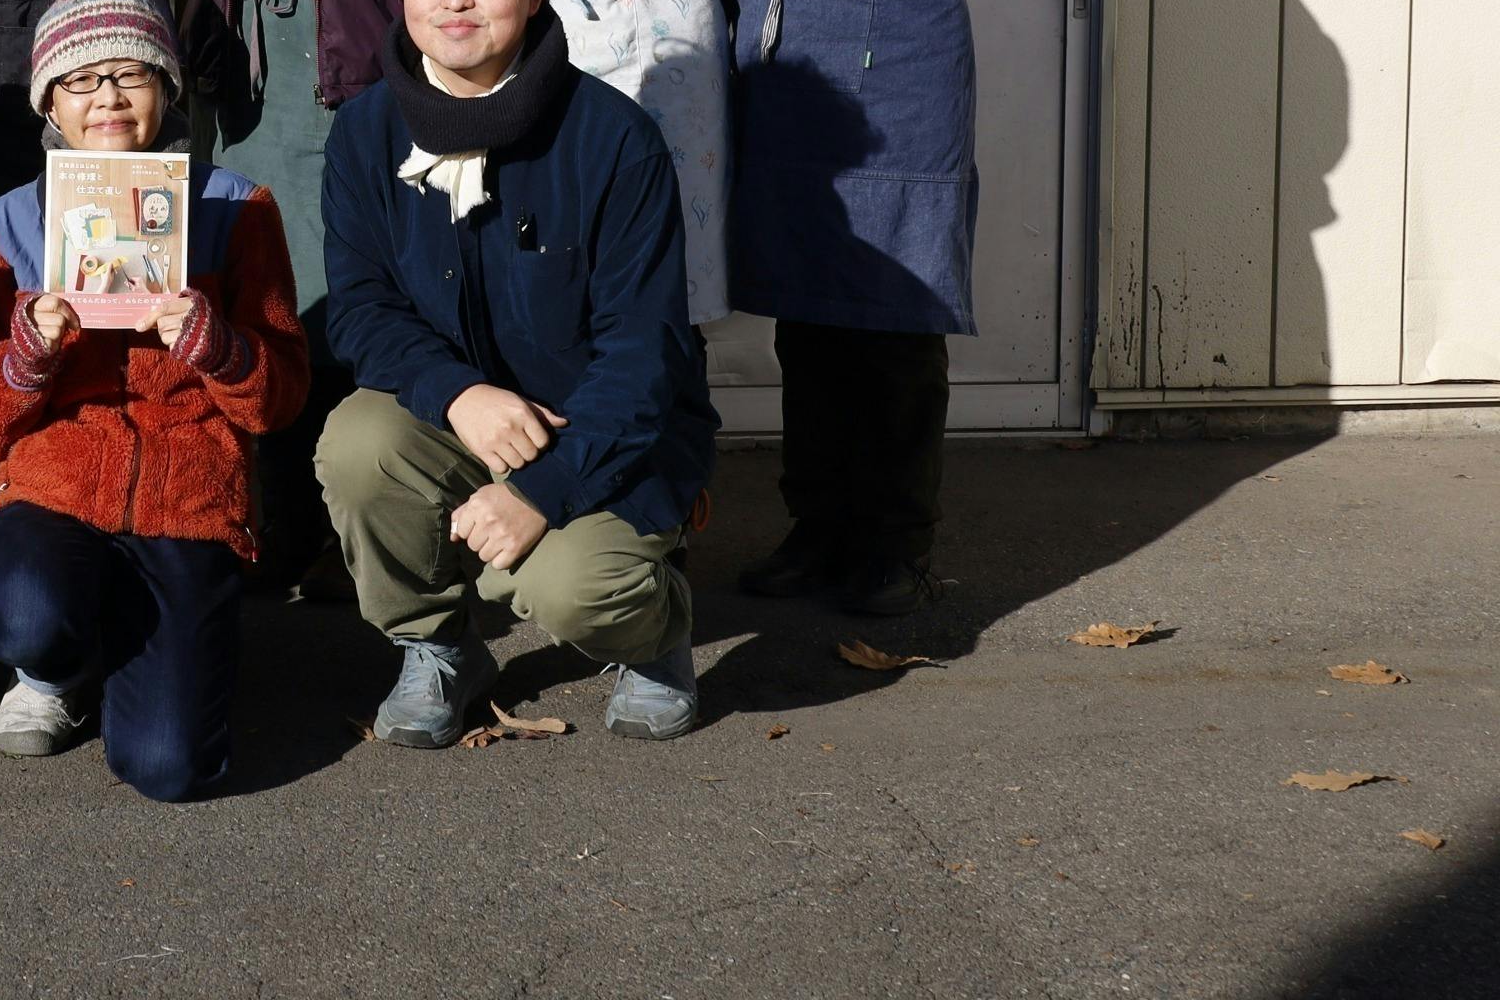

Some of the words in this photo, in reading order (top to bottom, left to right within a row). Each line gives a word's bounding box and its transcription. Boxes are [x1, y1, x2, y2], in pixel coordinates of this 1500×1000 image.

[76, 185, 122, 195] 仕立て直し
